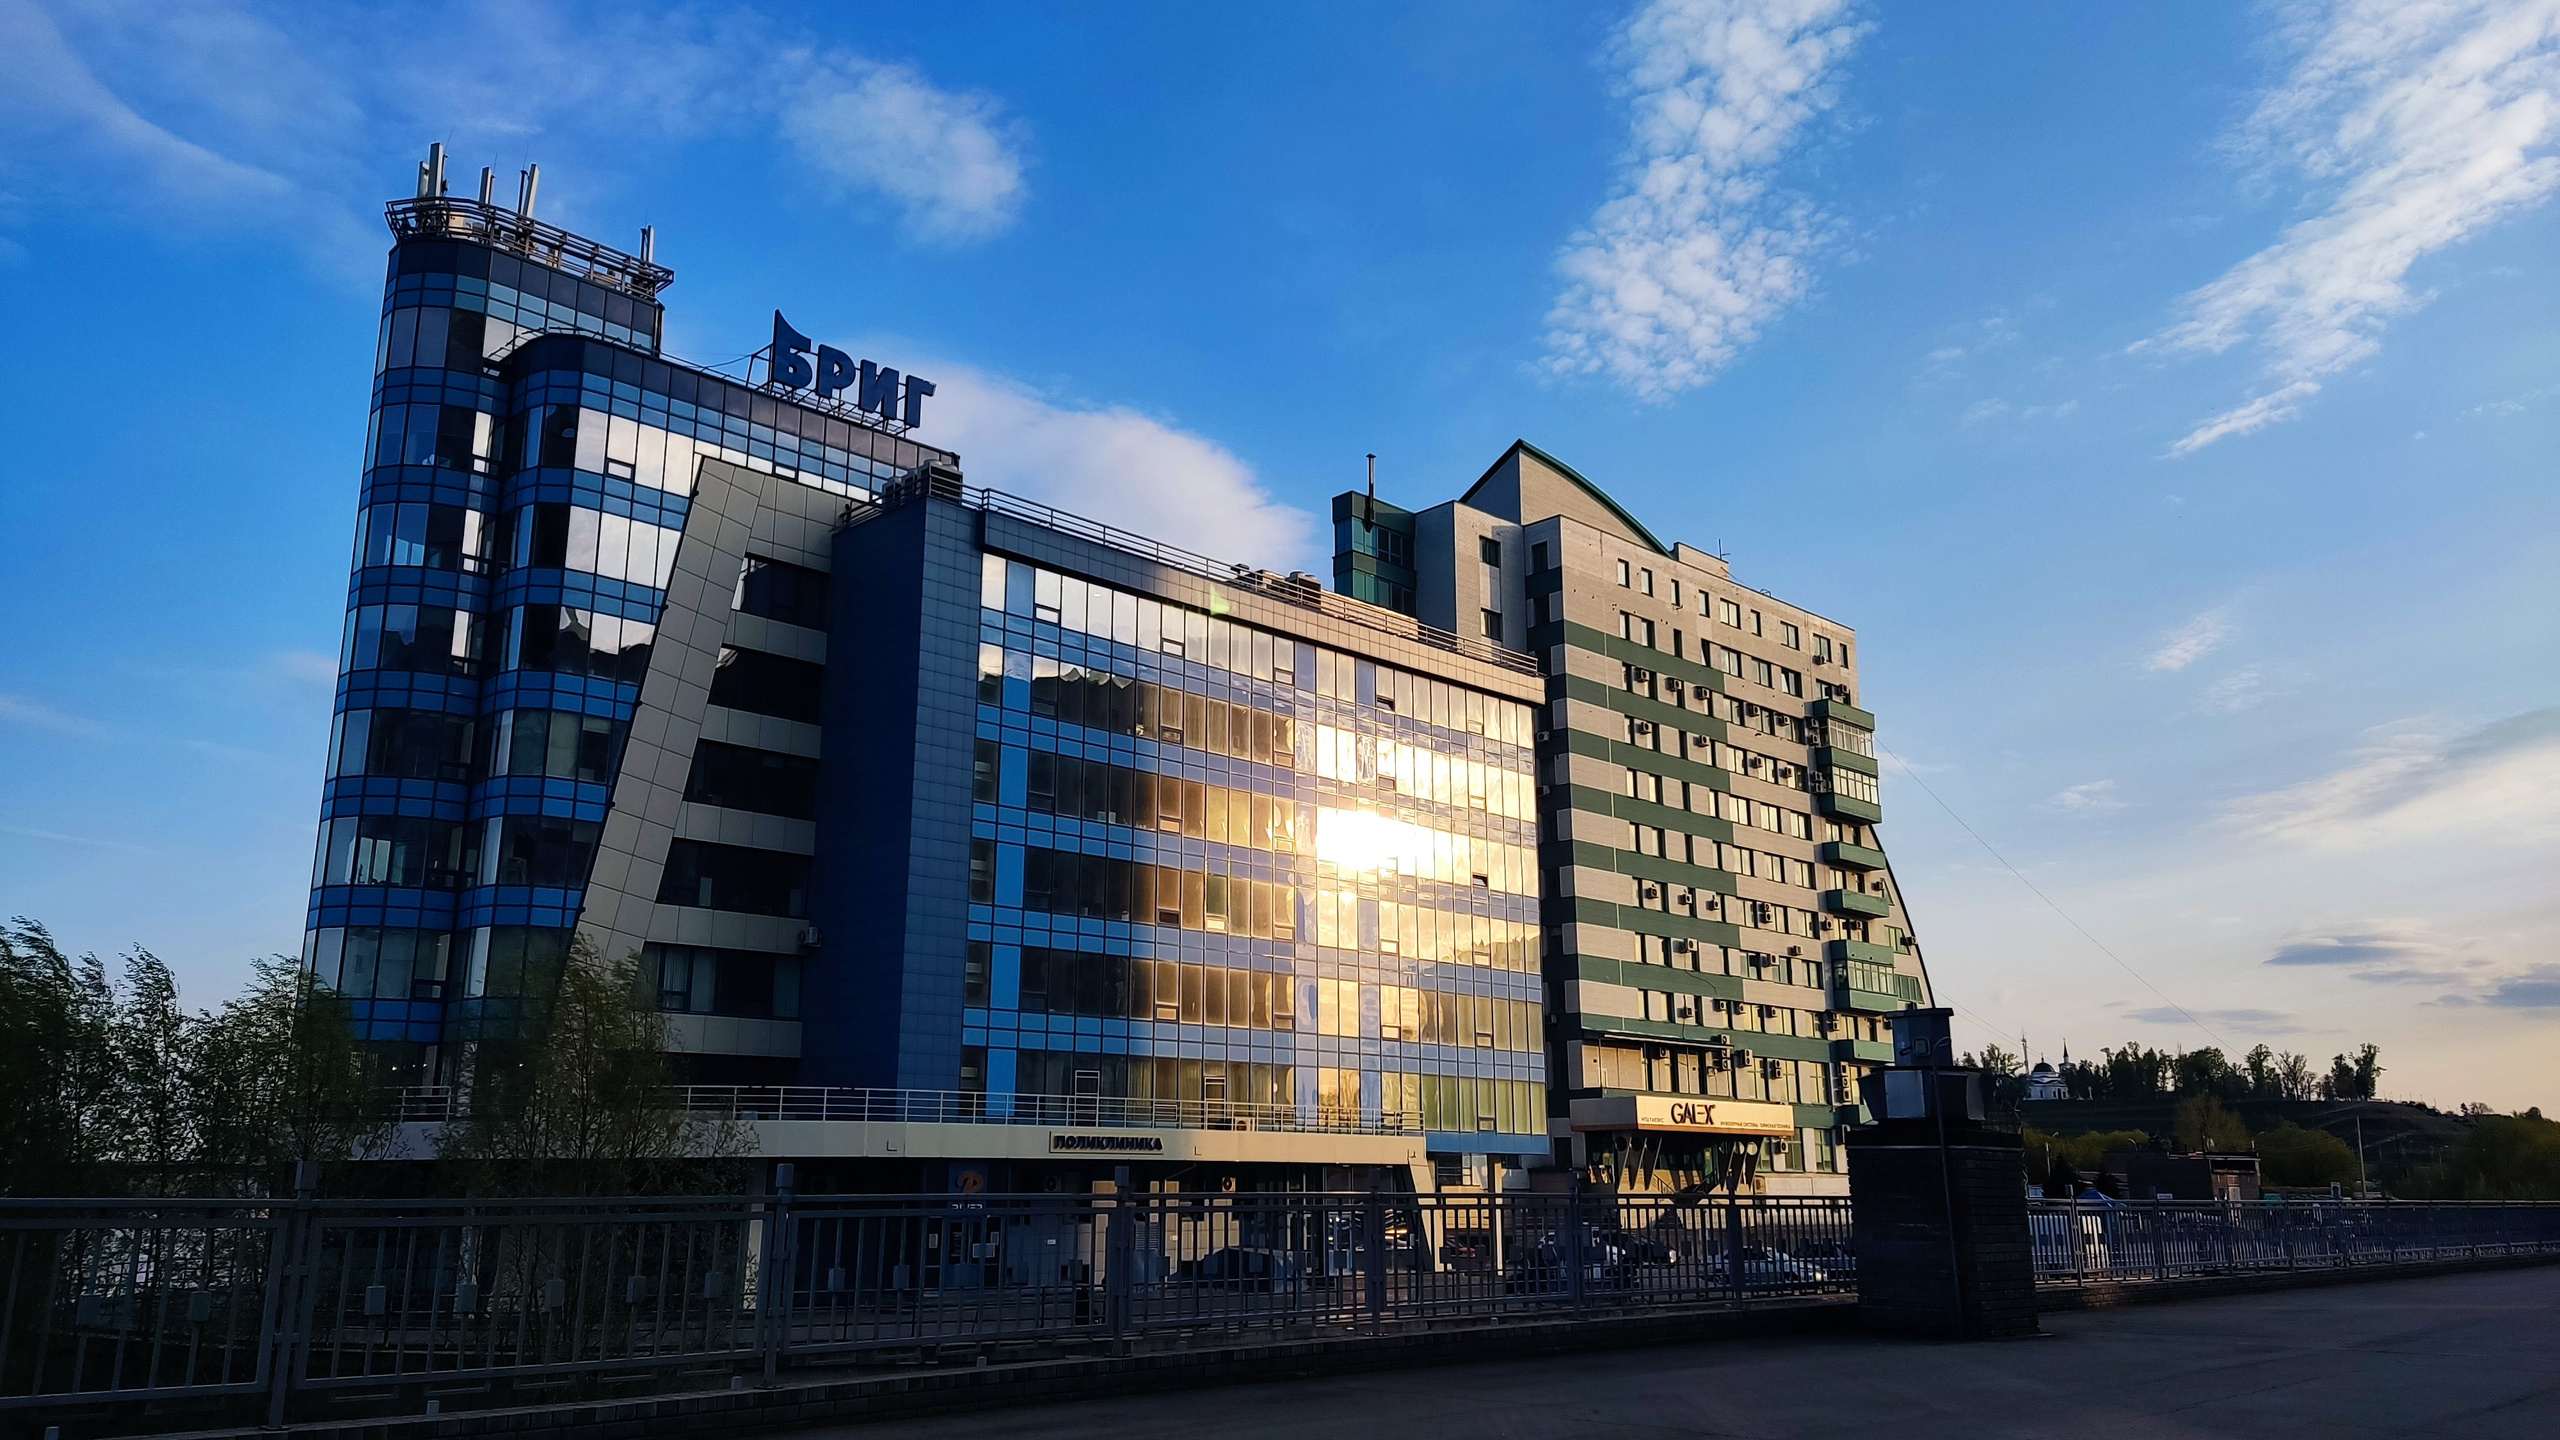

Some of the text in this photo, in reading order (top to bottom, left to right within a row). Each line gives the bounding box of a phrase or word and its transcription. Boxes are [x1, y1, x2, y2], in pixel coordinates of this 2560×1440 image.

[772, 309, 937, 428] БРИГ
[1671, 1103, 1714, 1125] GALEX
[1053, 1135, 1163, 1151] ПОЛИКЛИНИКА
